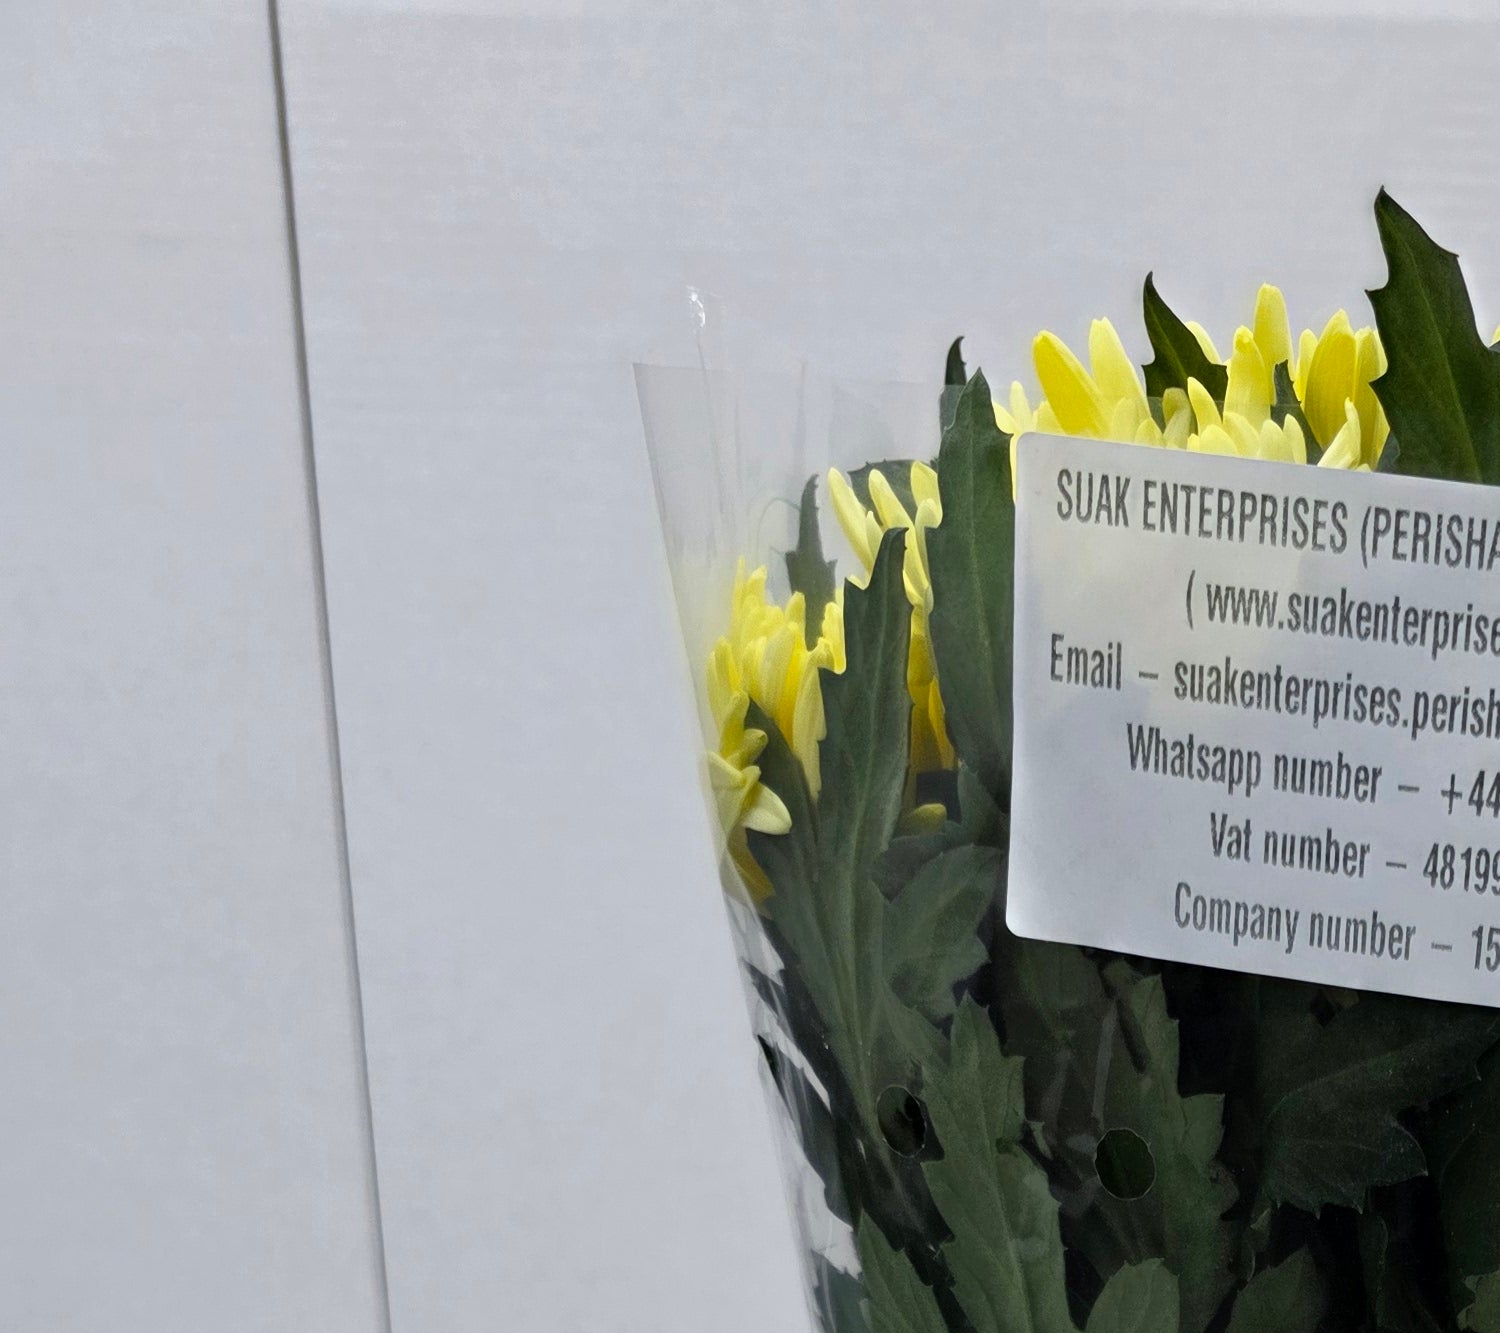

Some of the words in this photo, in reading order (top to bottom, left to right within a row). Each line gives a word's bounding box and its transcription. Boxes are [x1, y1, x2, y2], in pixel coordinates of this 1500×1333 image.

[1056, 467, 1131, 528] SUAK
[1142, 479, 1348, 554] ENTERPRISES
[1050, 631, 1123, 692] Email
[1126, 722, 1262, 798] Whatsapp
[1273, 750, 1383, 804] number
[1210, 811, 1252, 863] Vat
[1263, 827, 1371, 879] number
[1174, 881, 1301, 955] Company
[1308, 909, 1417, 961] number
